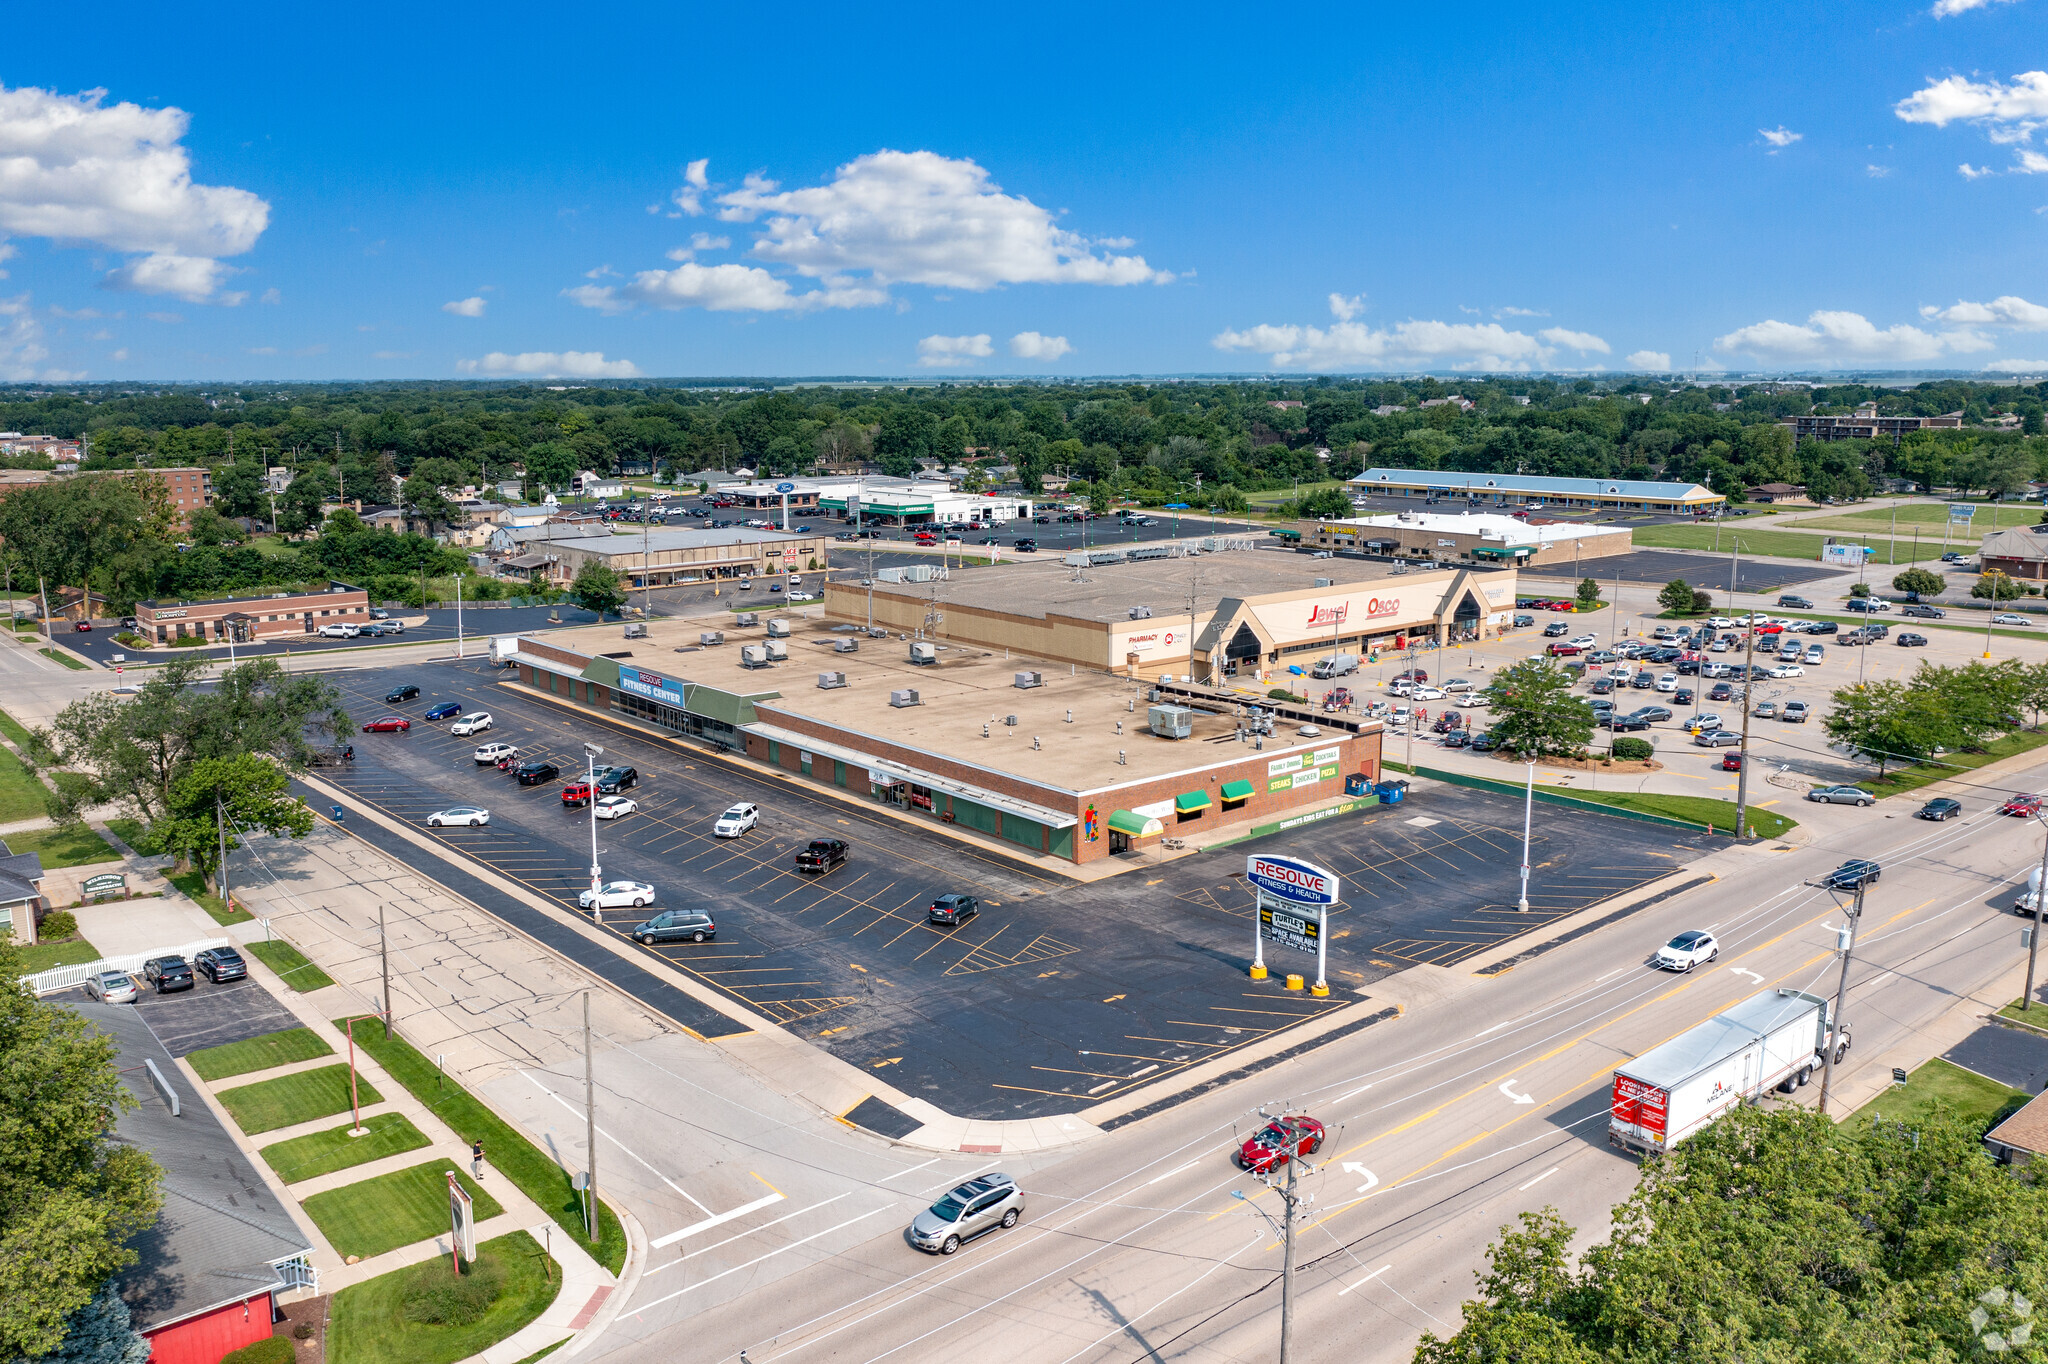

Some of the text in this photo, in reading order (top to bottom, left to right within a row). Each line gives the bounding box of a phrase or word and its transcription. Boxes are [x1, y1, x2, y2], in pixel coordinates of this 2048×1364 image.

[1340, 526, 1357, 535] LANES
[784, 547, 798, 556] ACE
[1307, 597, 1400, 623] Jewel Osco
[1128, 633, 1159, 644] PHARMACY
[639, 673, 662, 687] RESOLVE
[623, 678, 681, 704] FITNESS CENTER
[1315, 751, 1337, 762] COCKTAILS
[1295, 772, 1317, 784] CHICKEN
[1321, 767, 1336, 778] PIZZA
[1270, 778, 1291, 790] STEAKS
[1279, 817, 1303, 829] SUNDAYS
[1303, 814, 1315, 824] KIDS
[1315, 811, 1325, 819] EAT
[1325, 808, 1335, 817] FOR
[1255, 861, 1324, 892] RESOLVE
[1257, 877, 1287, 891] FITNESS
[1295, 887, 1321, 902] HEALTH
[1274, 914, 1304, 930] TURTLE'S
[1271, 926, 1289, 938] SPACE
[1289, 932, 1317, 948] AVAILABLE
[1620, 1078, 1649, 1092] LOOKING
